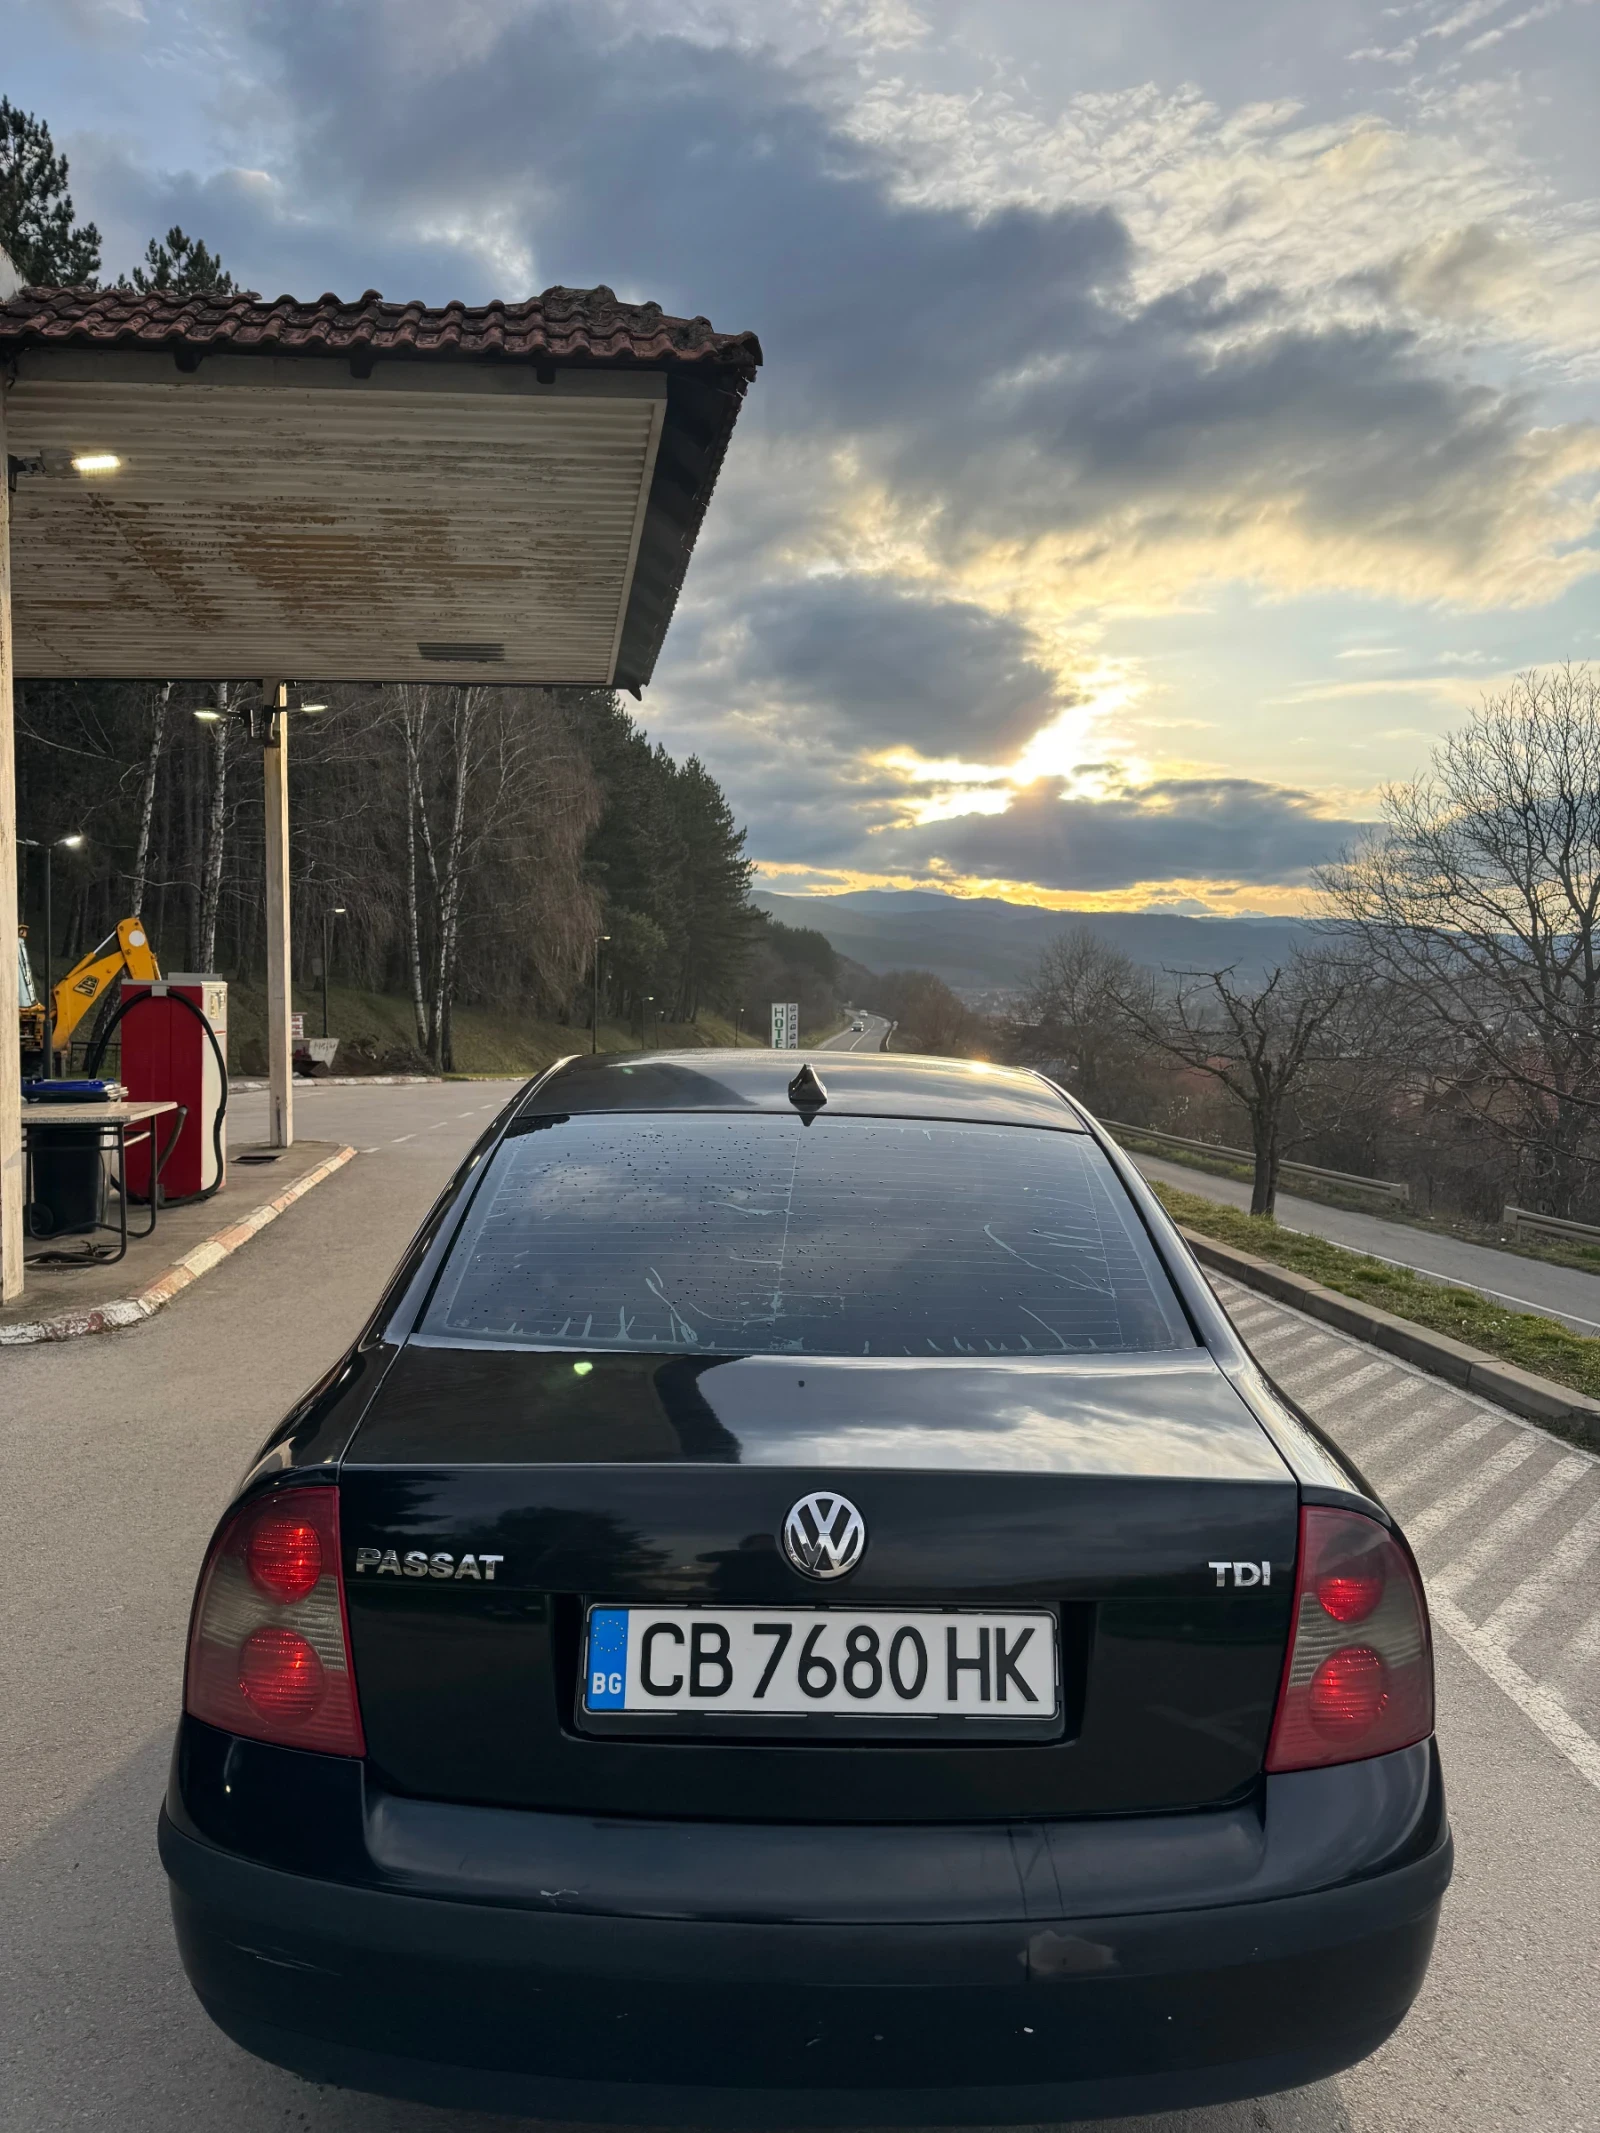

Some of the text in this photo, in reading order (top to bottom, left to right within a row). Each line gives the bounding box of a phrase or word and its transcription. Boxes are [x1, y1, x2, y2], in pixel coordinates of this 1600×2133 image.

[78, 976, 98, 995] JCB
[783, 1491, 866, 1579] VW
[355, 1547, 504, 1581] PASSAT
[1207, 1560, 1271, 1588] TDI
[640, 1621, 1039, 1702] CB 7680 HK
[591, 1672, 622, 1695] BG
